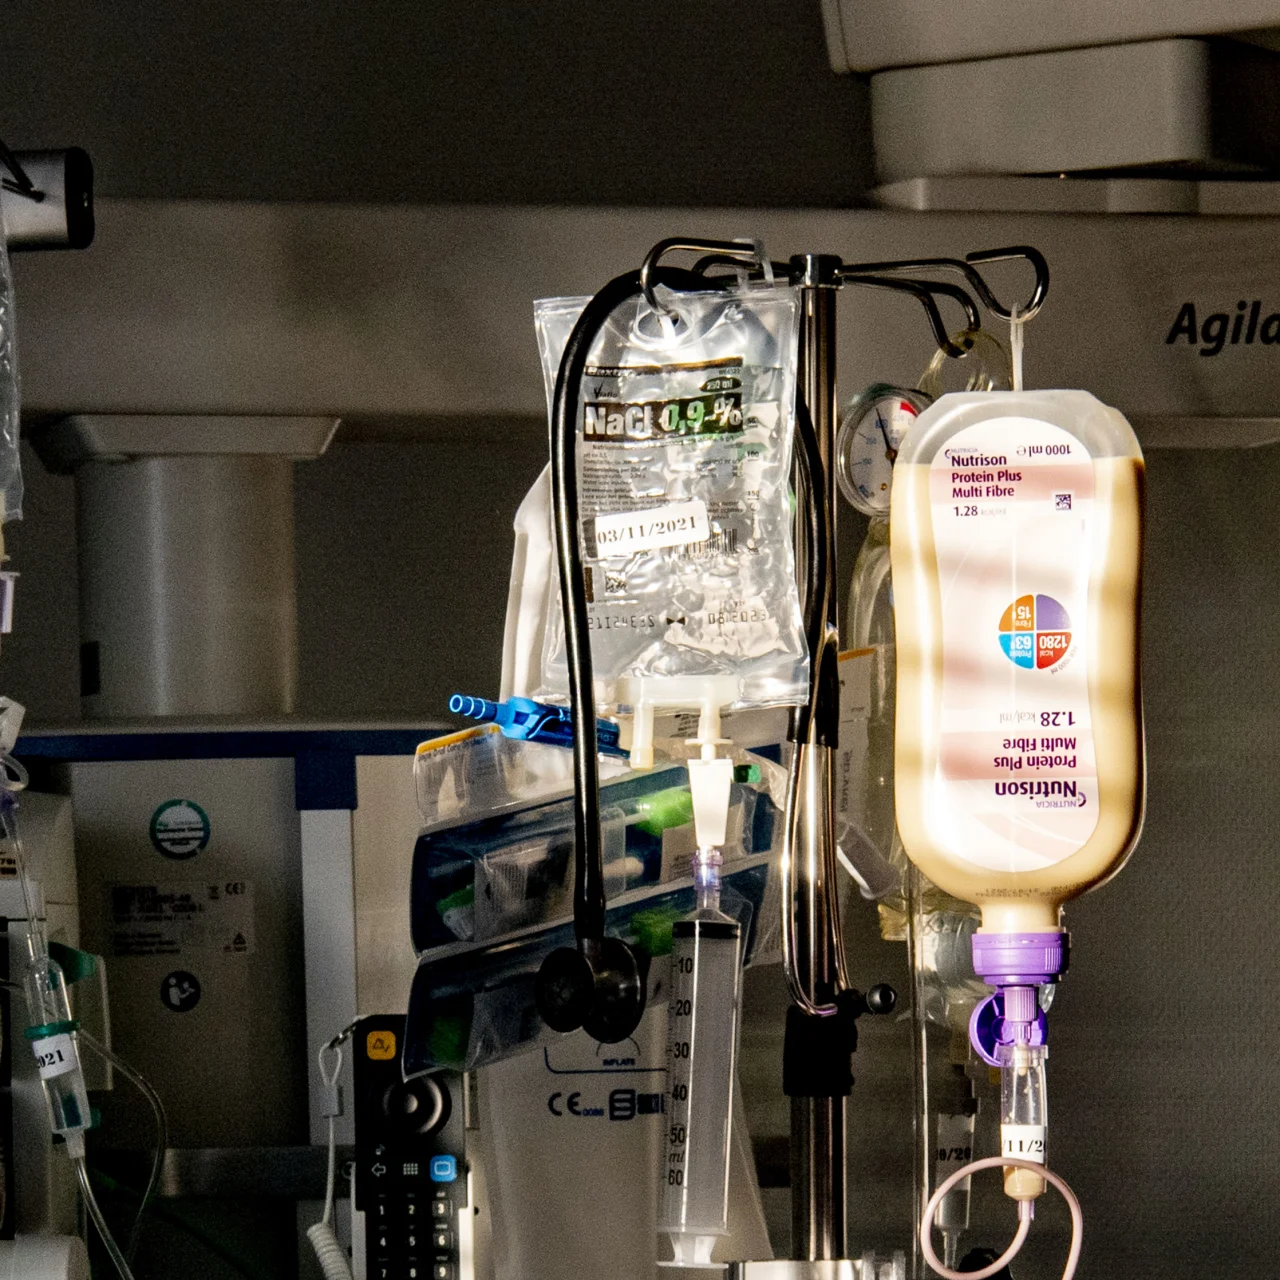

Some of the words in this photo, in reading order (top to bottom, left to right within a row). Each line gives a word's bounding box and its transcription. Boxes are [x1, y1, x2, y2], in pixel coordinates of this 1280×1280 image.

[584, 405, 653, 440] NaCl
[659, 399, 705, 436] 0,9
[1028, 445, 1043, 457] ml
[1045, 444, 1072, 456] 1000
[951, 453, 1007, 467] Nutrison
[951, 471, 994, 483] Protein
[997, 469, 1023, 482] Plus
[952, 486, 982, 499] Multi
[986, 485, 1015, 497] Fibre
[953, 505, 978, 517] 1.28
[596, 516, 697, 545] 03/11/2021
[1016, 605, 1032, 619] 15
[1039, 635, 1068, 649] 1280
[999, 710, 1036, 724] kcal/ml
[1040, 711, 1076, 727] 1.28
[1002, 737, 1037, 753] Fibre
[1040, 737, 1077, 752] Multi
[993, 756, 1022, 771] Plus
[1026, 755, 1077, 770] Protein
[994, 781, 1077, 800] Nutrison
[1035, 800, 1077, 808] NUTRICIA
[677, 957, 693, 974] 10
[675, 999, 692, 1017] 20
[673, 1042, 689, 1059] 30
[35, 1049, 64, 1068] 021
[603, 1058, 636, 1066] INFLATE
[671, 1084, 688, 1102] 40
[669, 1127, 686, 1144] 50
[668, 1150, 685, 1164] ml
[668, 1169, 684, 1186] 60
